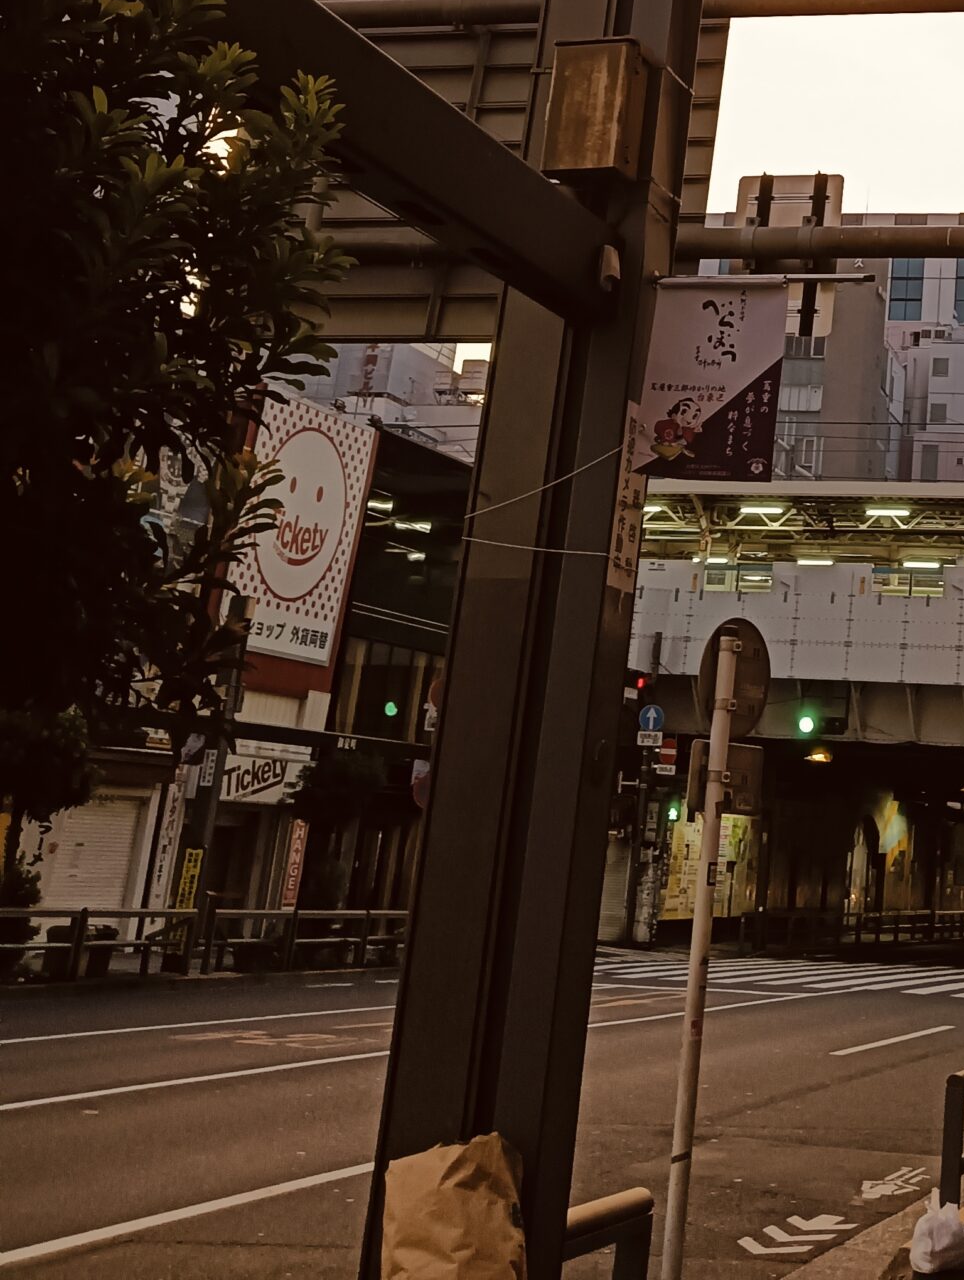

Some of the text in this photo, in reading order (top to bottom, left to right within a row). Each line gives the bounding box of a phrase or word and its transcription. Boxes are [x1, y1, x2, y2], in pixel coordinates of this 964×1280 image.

[290, 625, 328, 649] 外貨両替
[223, 760, 288, 797] Tickety
